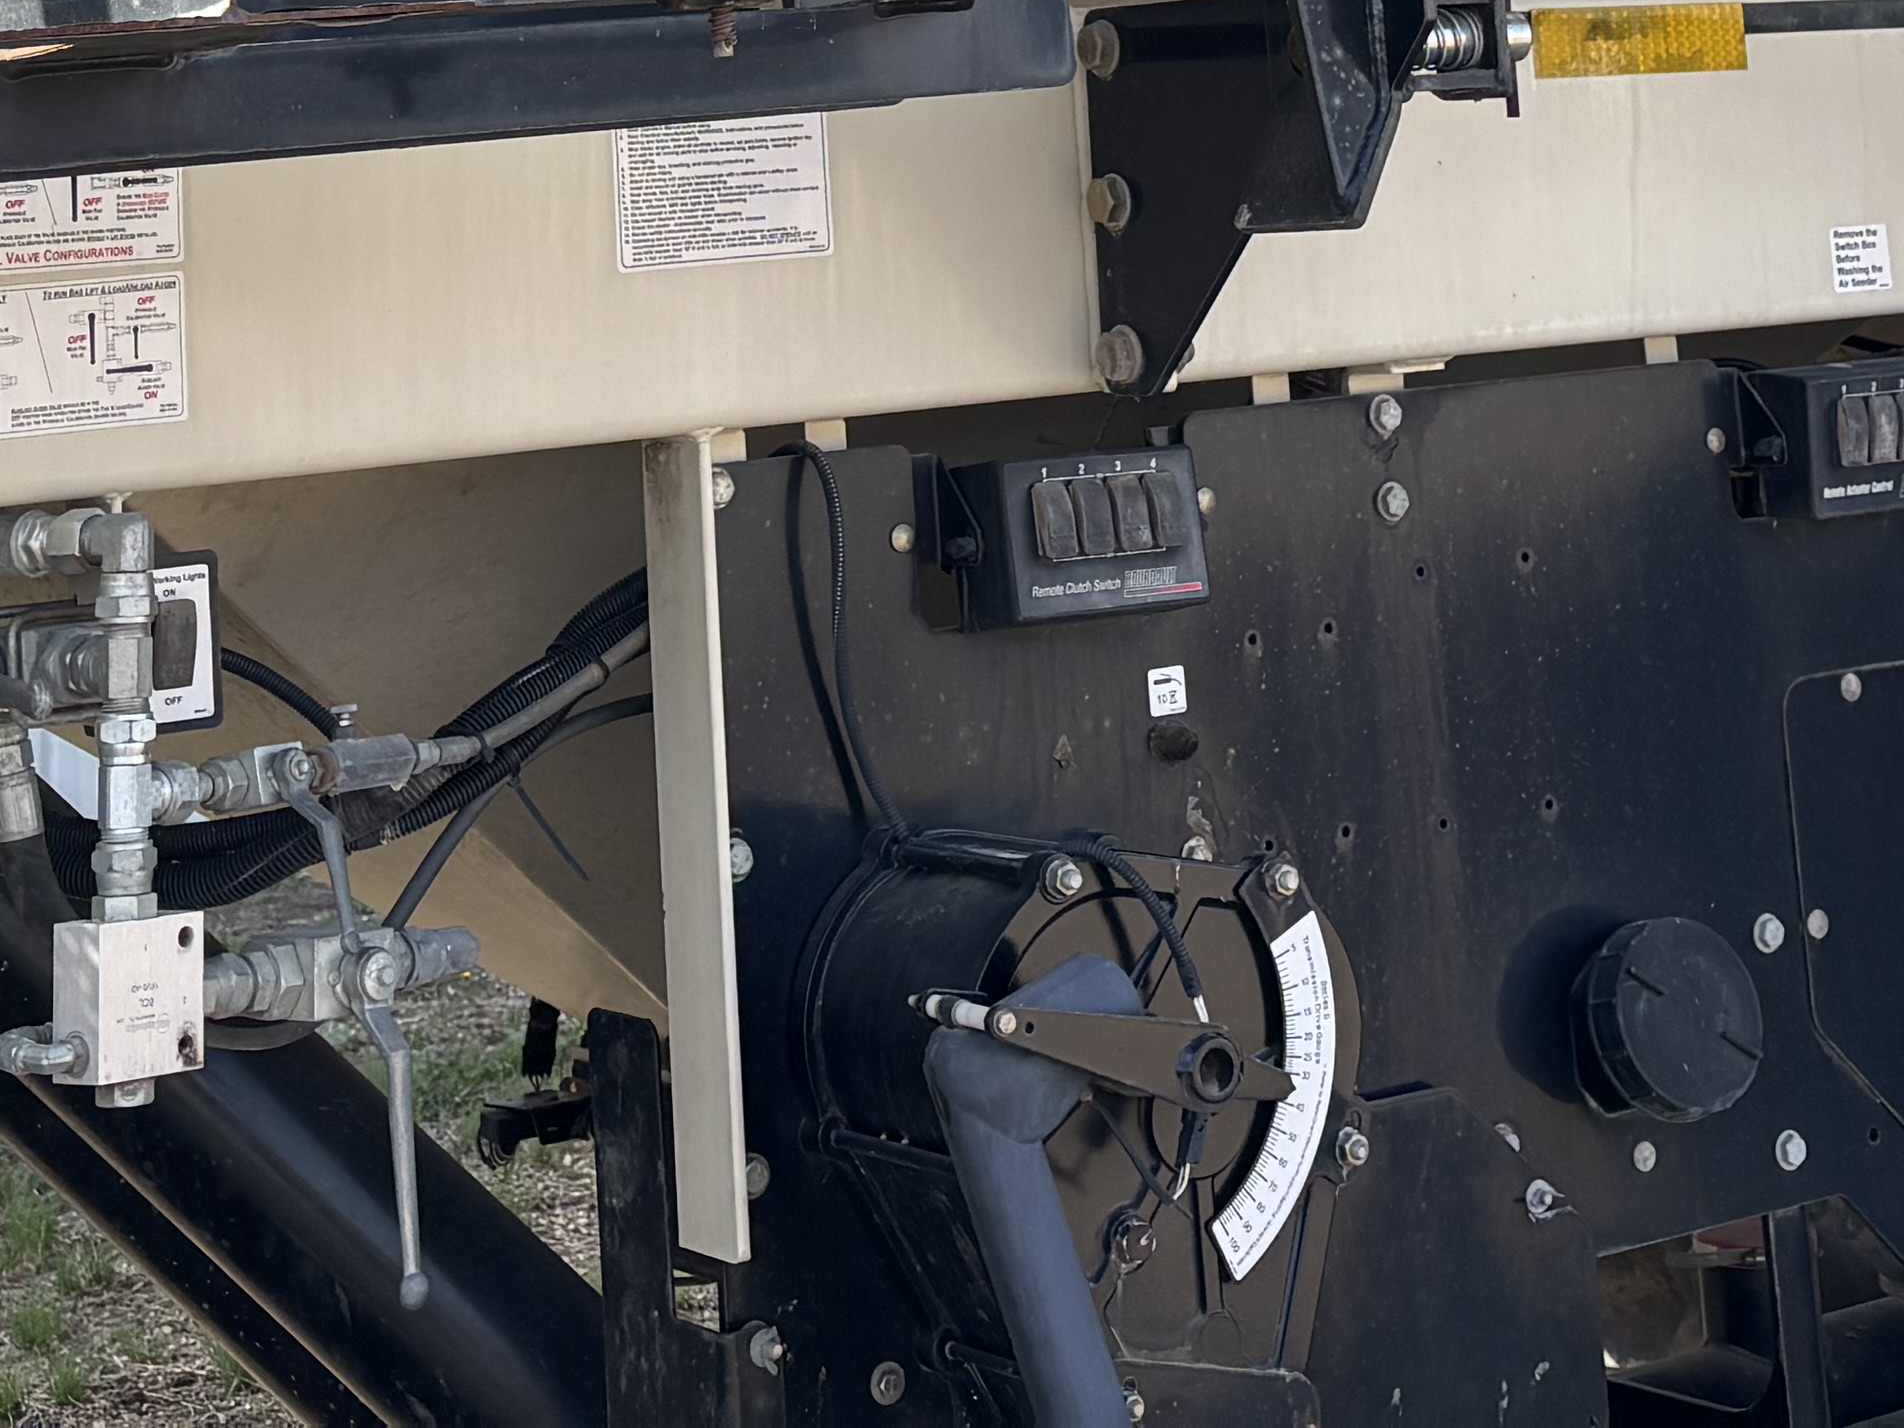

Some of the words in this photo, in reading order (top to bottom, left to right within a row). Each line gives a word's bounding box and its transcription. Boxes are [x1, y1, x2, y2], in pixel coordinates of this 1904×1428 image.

[6, 251, 40, 265] VALVE
[43, 245, 134, 263] CONFIGURATIONS
[137, 295, 156, 306] OFF
[67, 334, 87, 345] OFF
[144, 390, 158, 400] ON
[1041, 467, 1047, 478] 1
[1078, 463, 1085, 474] 2
[1115, 460, 1122, 471] 3
[1150, 458, 1157, 468] 4
[183, 571, 206, 583] Lights
[162, 588, 176, 597] ON
[1032, 584, 1065, 598] Remote
[1066, 580, 1092, 594] Clutch
[1093, 577, 1122, 592] Switch
[164, 696, 183, 706] OFF
[1302, 935, 1320, 1002] Transmission
